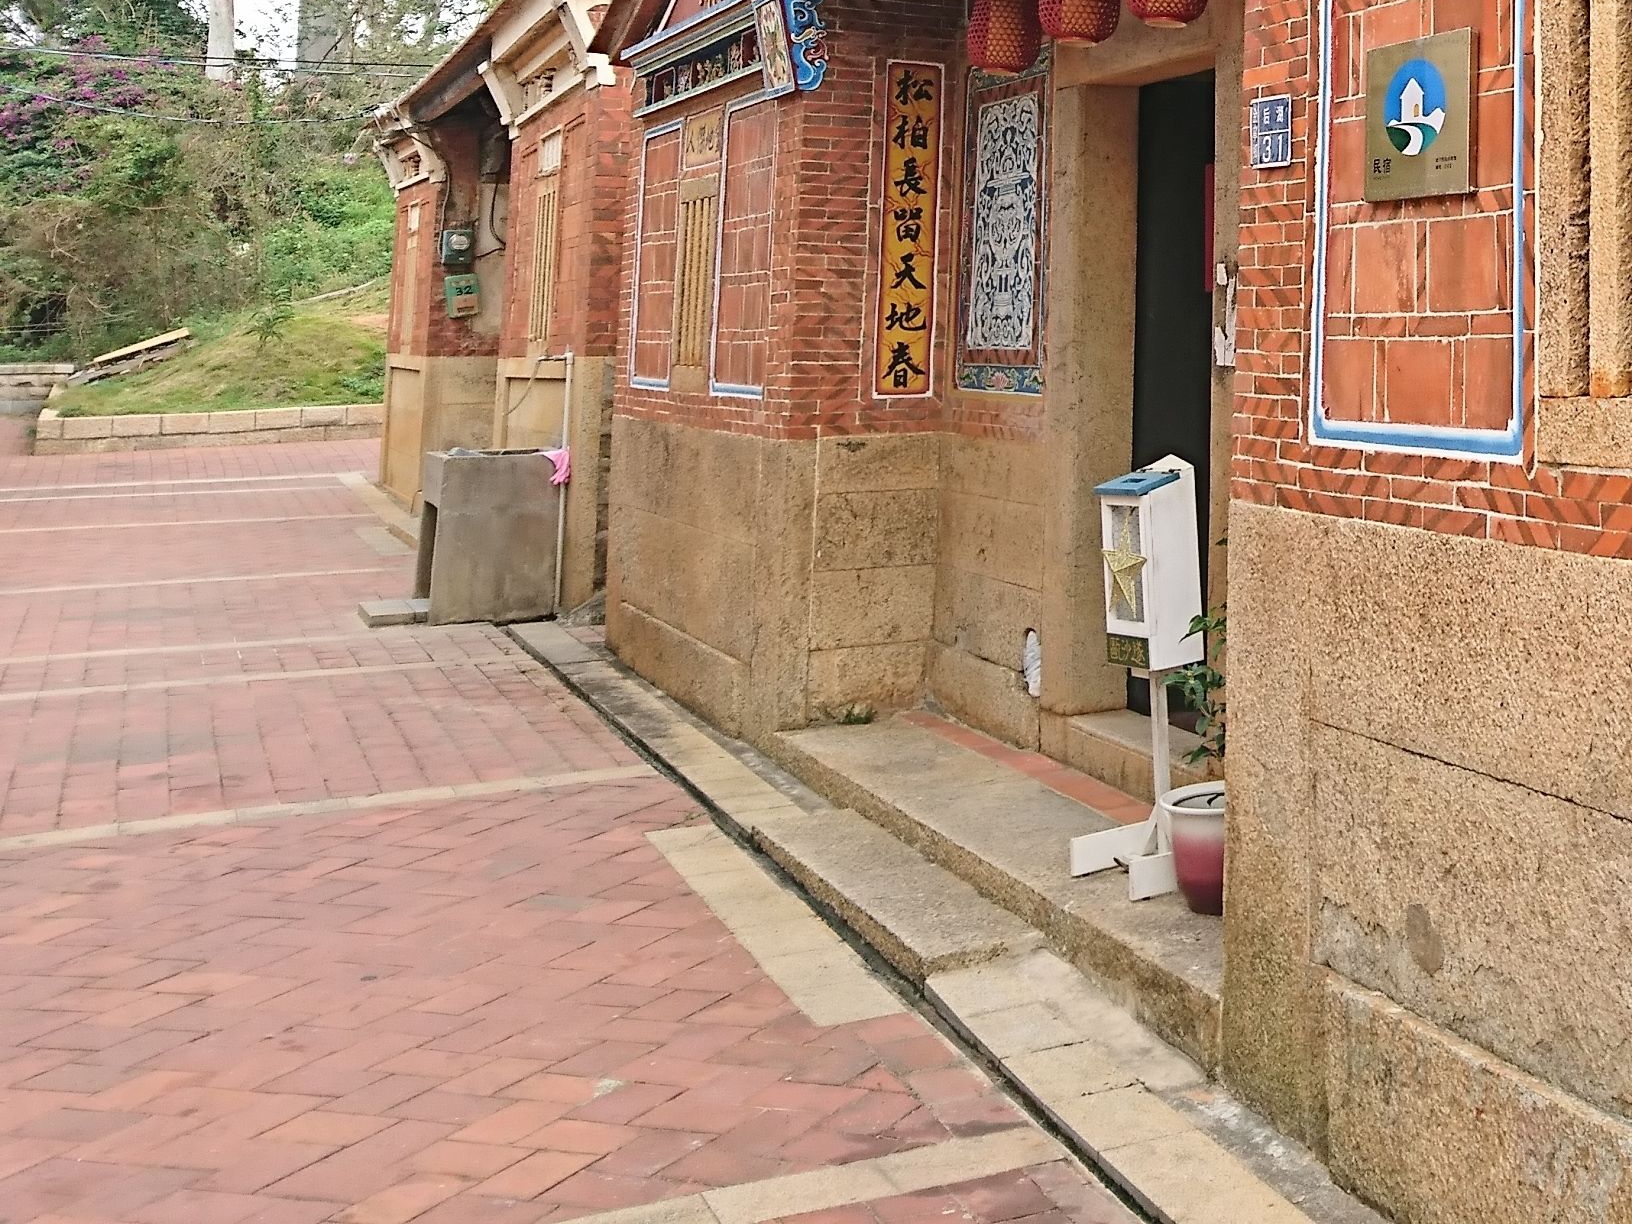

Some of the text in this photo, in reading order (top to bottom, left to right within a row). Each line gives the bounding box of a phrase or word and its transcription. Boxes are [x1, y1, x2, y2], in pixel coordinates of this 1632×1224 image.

[1262, 133, 1284, 163] 31
[1373, 157, 1391, 174] 民宿
[456, 285, 473, 296] 32
